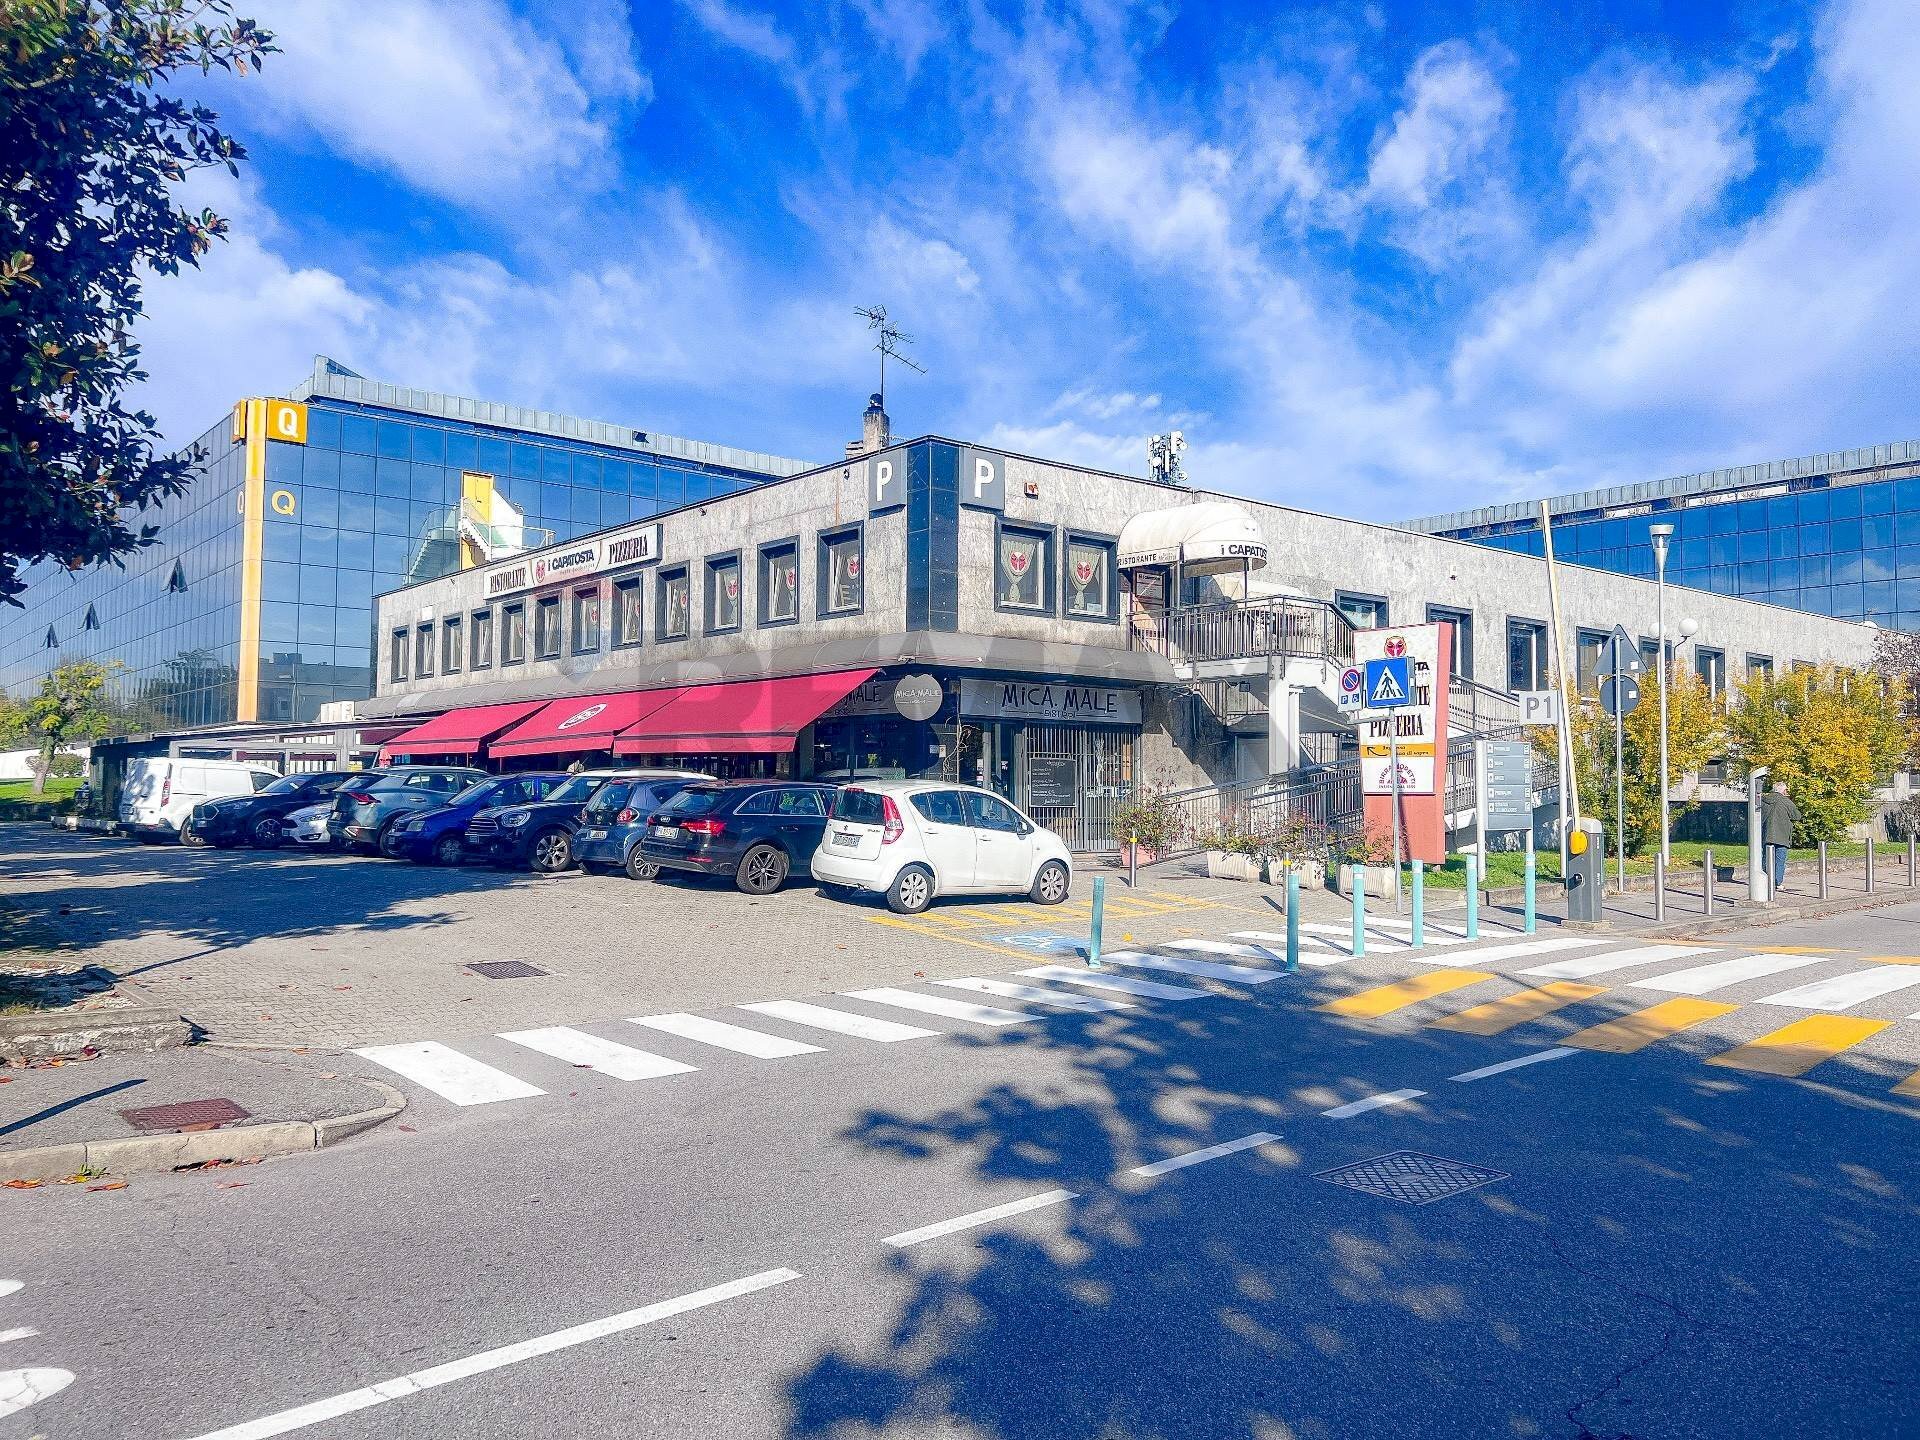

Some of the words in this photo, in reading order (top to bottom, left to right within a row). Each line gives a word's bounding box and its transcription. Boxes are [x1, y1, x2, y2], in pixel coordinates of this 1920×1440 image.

[278, 407, 298, 438] Q
[876, 460, 893, 502] P
[974, 457, 995, 499] P
[271, 490, 296, 517] Q
[489, 567, 527, 594] RISTORANTE
[551, 549, 595, 571] CAPATOSTA
[608, 533, 649, 565] PIZZERIA
[1118, 553, 1157, 566] RISTORANTE
[1062, 688, 1118, 713] MALE
[1526, 695, 1552, 720] P1
